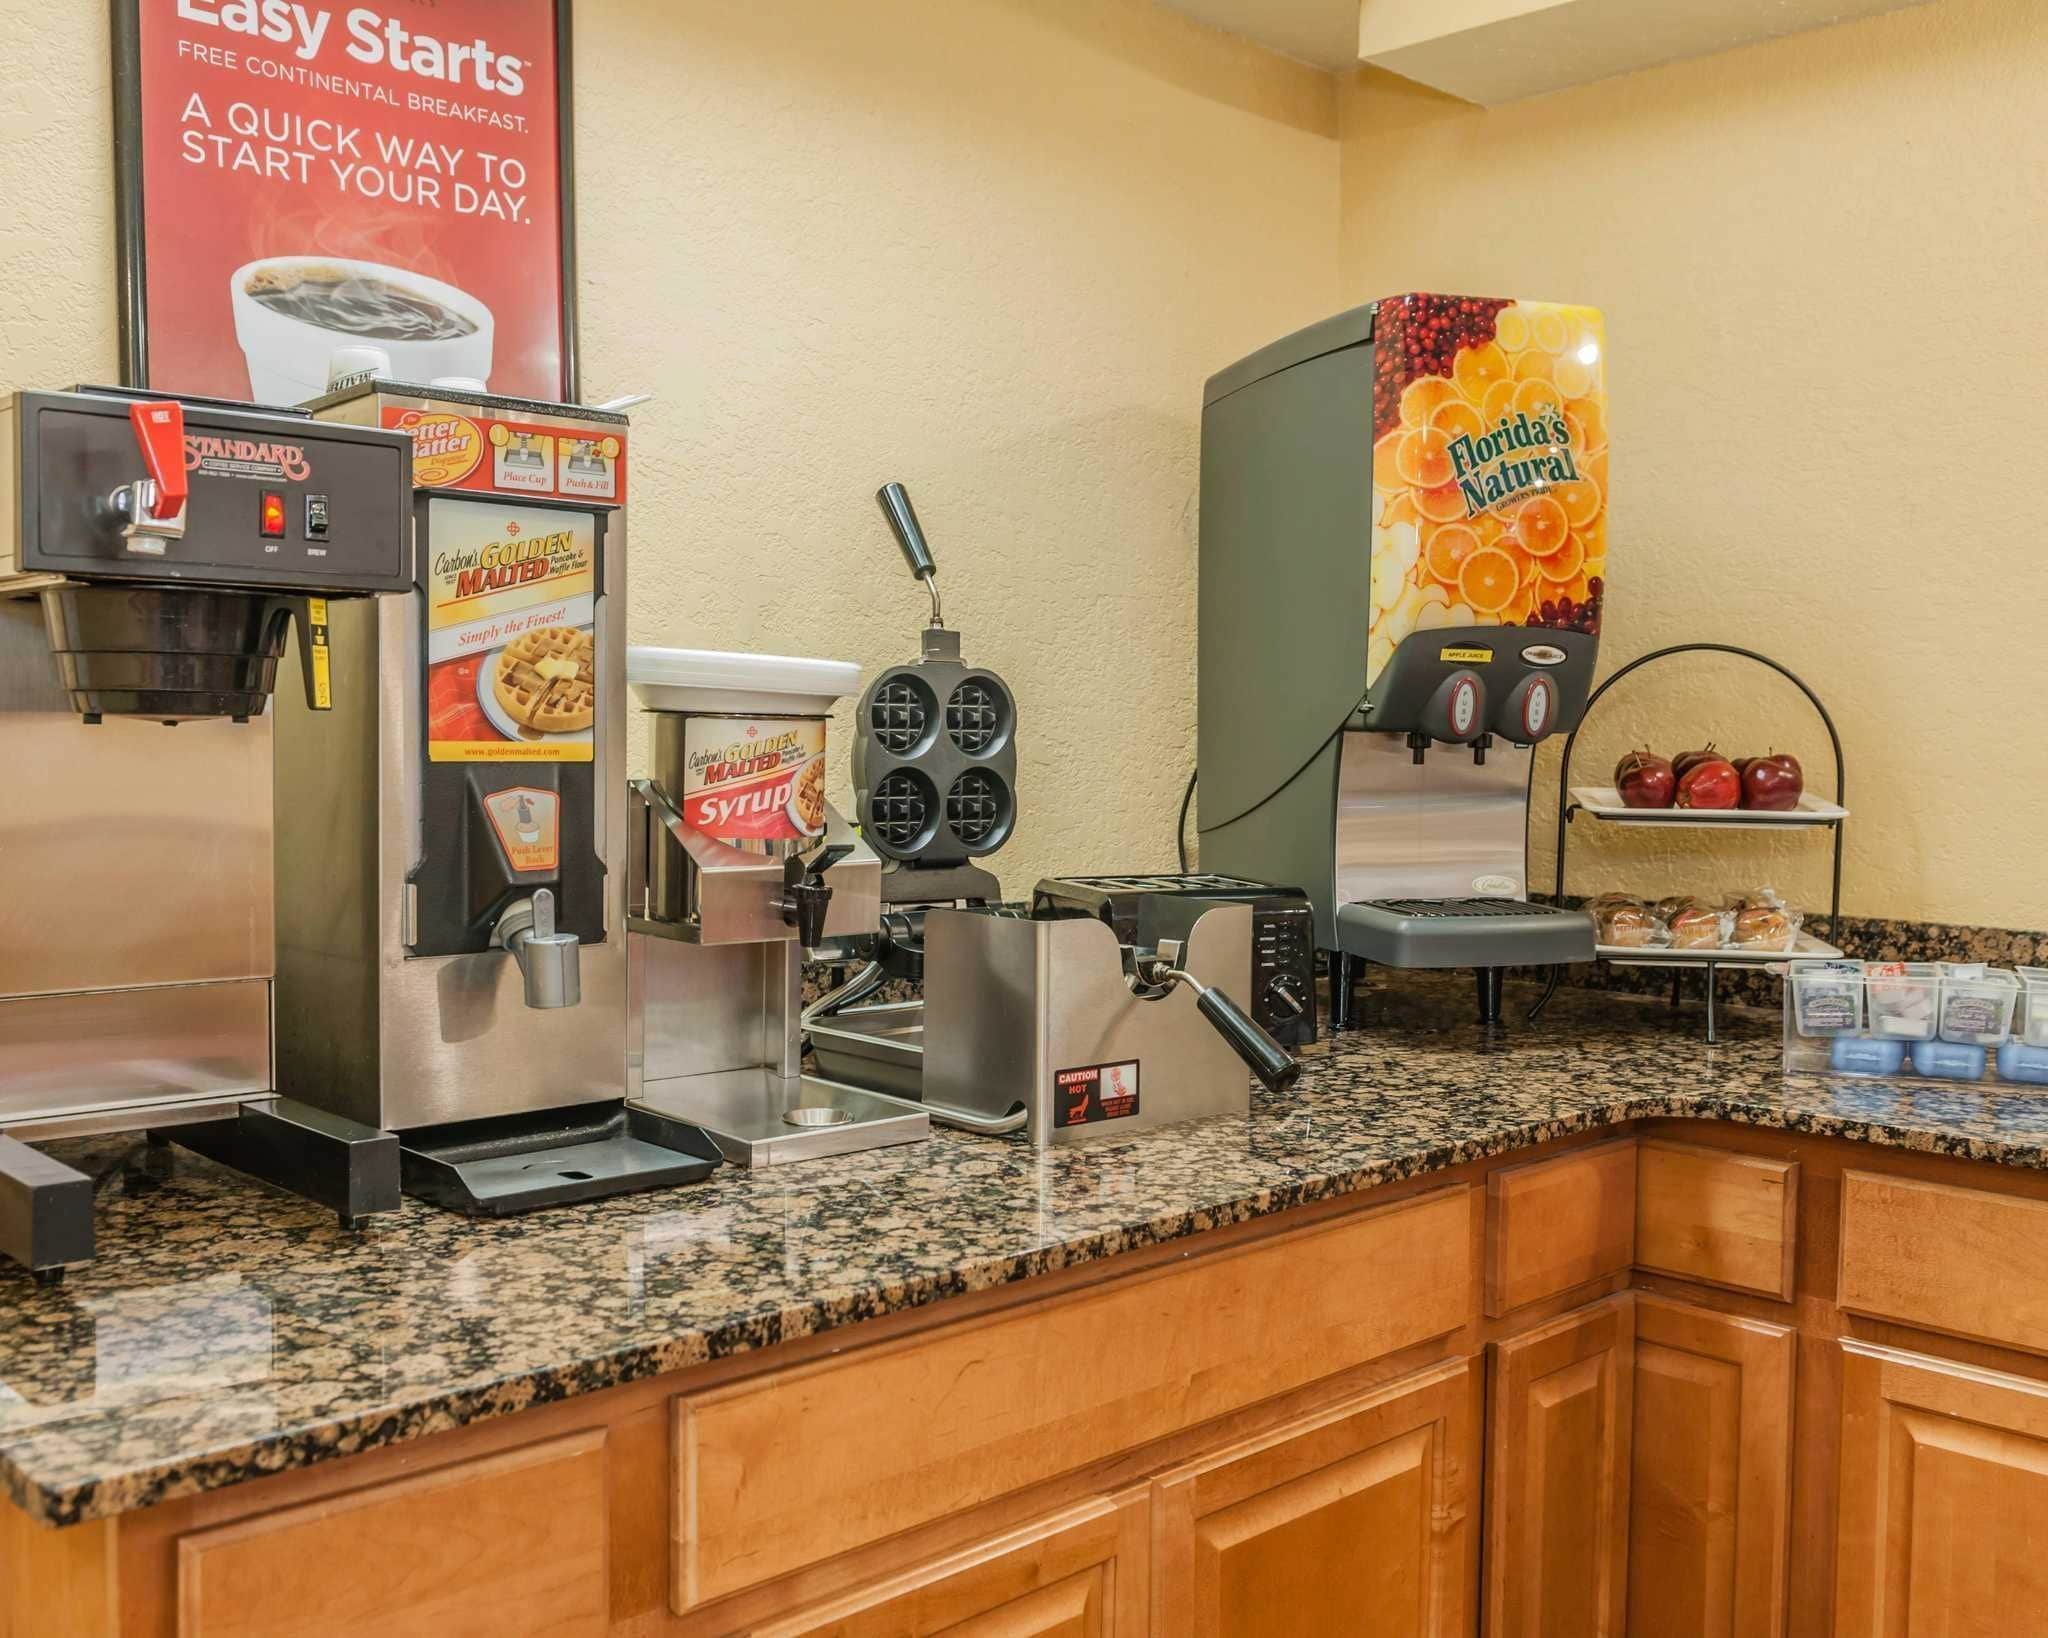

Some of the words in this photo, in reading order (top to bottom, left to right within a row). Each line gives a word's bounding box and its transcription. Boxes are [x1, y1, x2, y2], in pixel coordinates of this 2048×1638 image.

[345, 7, 525, 97] Starts
[178, 40, 238, 70] FREE
[246, 56, 400, 107] CONTINENTAL
[408, 92, 529, 134] BREAKFAST.
[180, 92, 212, 128] A
[228, 102, 361, 159] QUICK
[375, 132, 464, 177] WAY
[477, 152, 526, 189] TO
[182, 130, 315, 184] START
[329, 158, 441, 209] YOUR
[454, 183, 531, 225] DAY.
[402, 421, 459, 441] etter
[413, 434, 471, 458] atter
[1447, 412, 1570, 480] Florida's
[184, 435, 311, 481] STANDARD
[504, 471, 527, 481] Place
[529, 472, 546, 486] Cup
[1459, 447, 1580, 518] Natural
[265, 545, 279, 553] OFF
[479, 530, 574, 570] GOLDEN
[455, 557, 550, 598] MALTED
[458, 623, 499, 646] Simply
[504, 618, 522, 634] the
[526, 607, 566, 629] Finest!
[723, 729, 798, 763] GOLDEN
[703, 752, 782, 785] MALTED
[698, 783, 792, 826] Syrup
[1058, 1068, 1098, 1085] CAUTION
[1068, 1083, 1088, 1095] HOT
